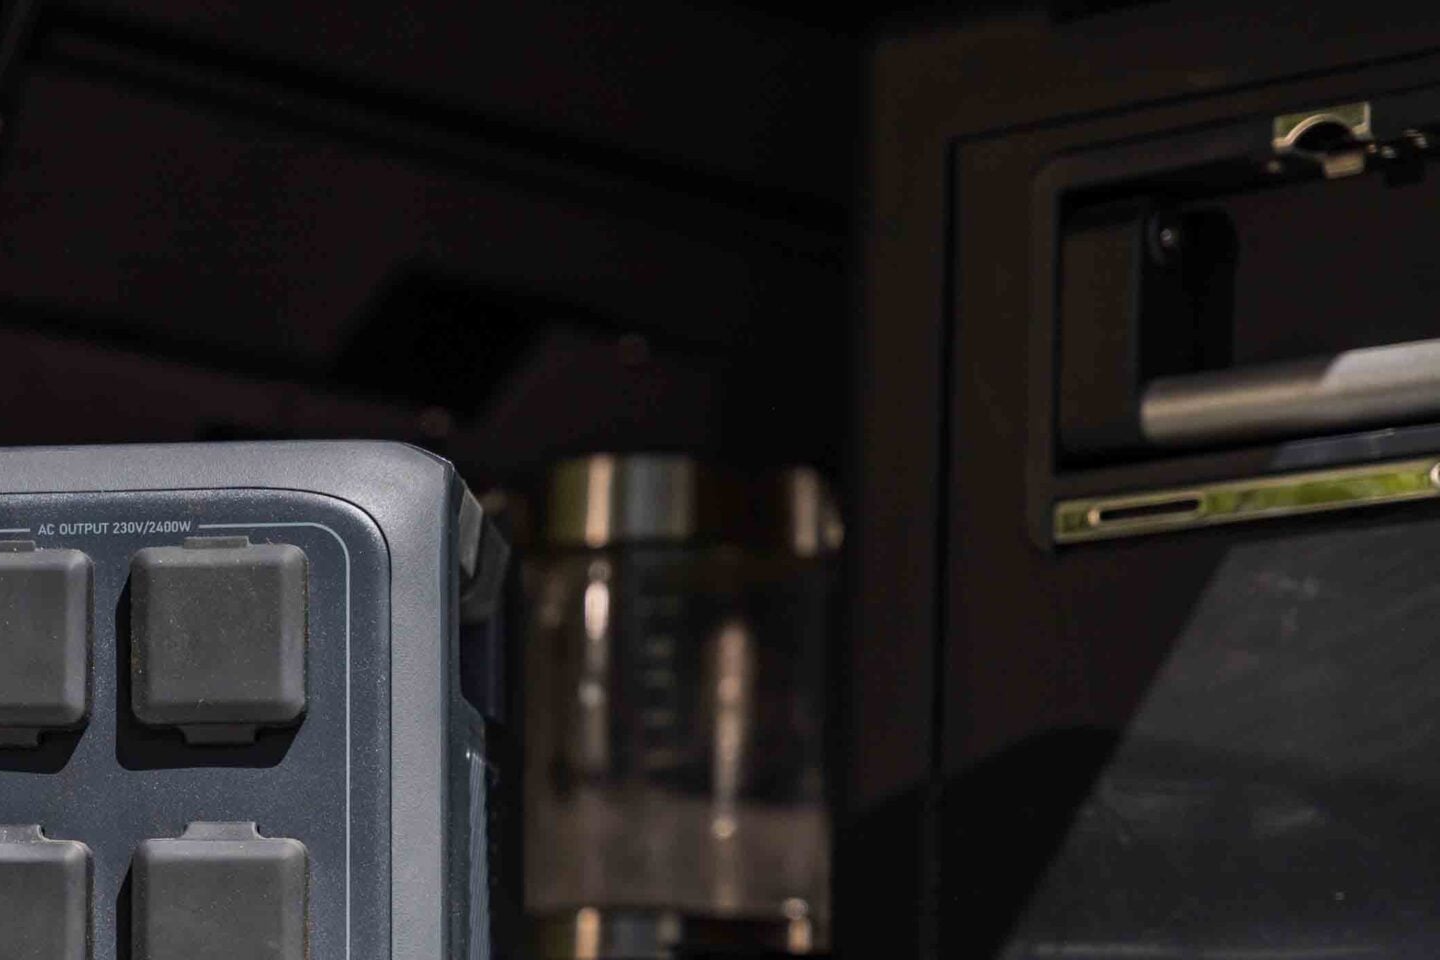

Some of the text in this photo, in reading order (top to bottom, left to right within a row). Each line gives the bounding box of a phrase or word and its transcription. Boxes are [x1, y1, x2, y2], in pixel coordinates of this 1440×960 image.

[38, 520, 192, 536] AC OUTPUT 230V/2400W
